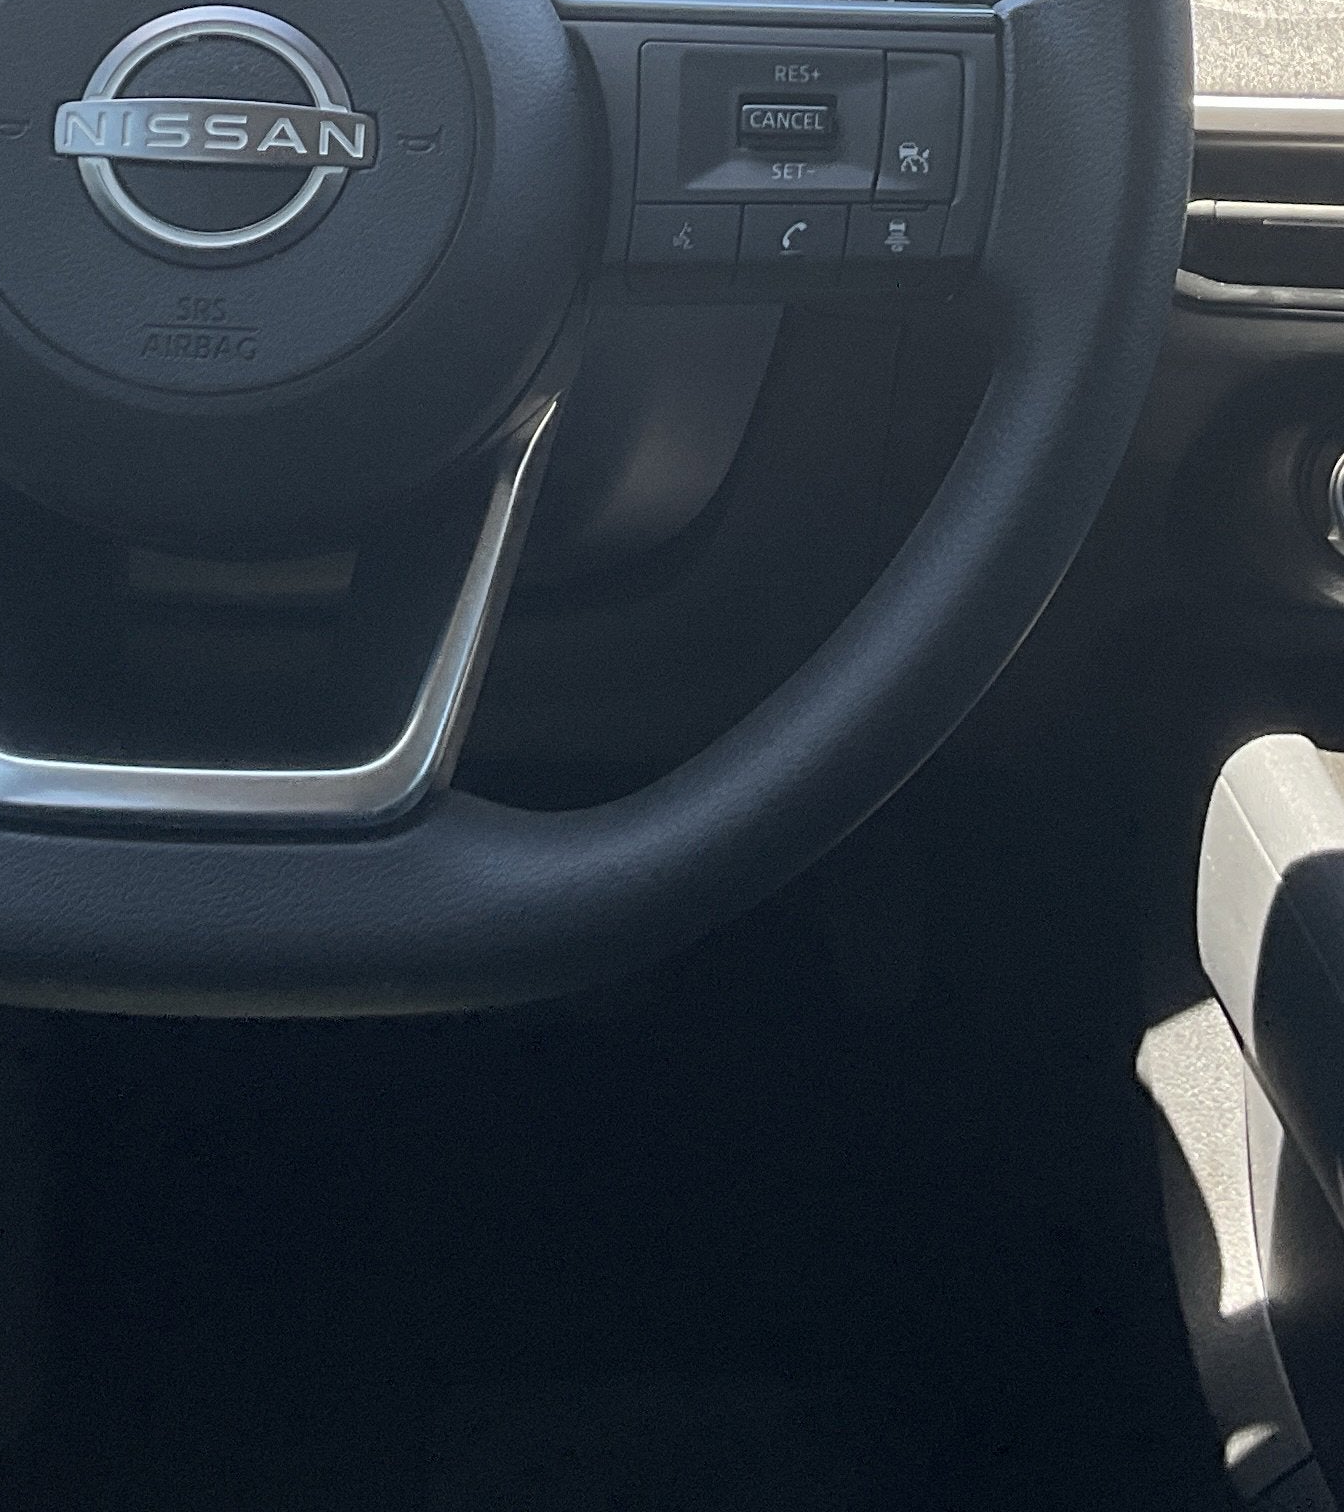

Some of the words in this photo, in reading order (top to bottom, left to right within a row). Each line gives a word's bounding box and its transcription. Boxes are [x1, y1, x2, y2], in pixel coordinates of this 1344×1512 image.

[748, 109, 825, 131] CANCEL
[63, 111, 366, 159] NISSAN
[176, 296, 227, 323] SRS
[140, 331, 258, 362] AIRBAG
